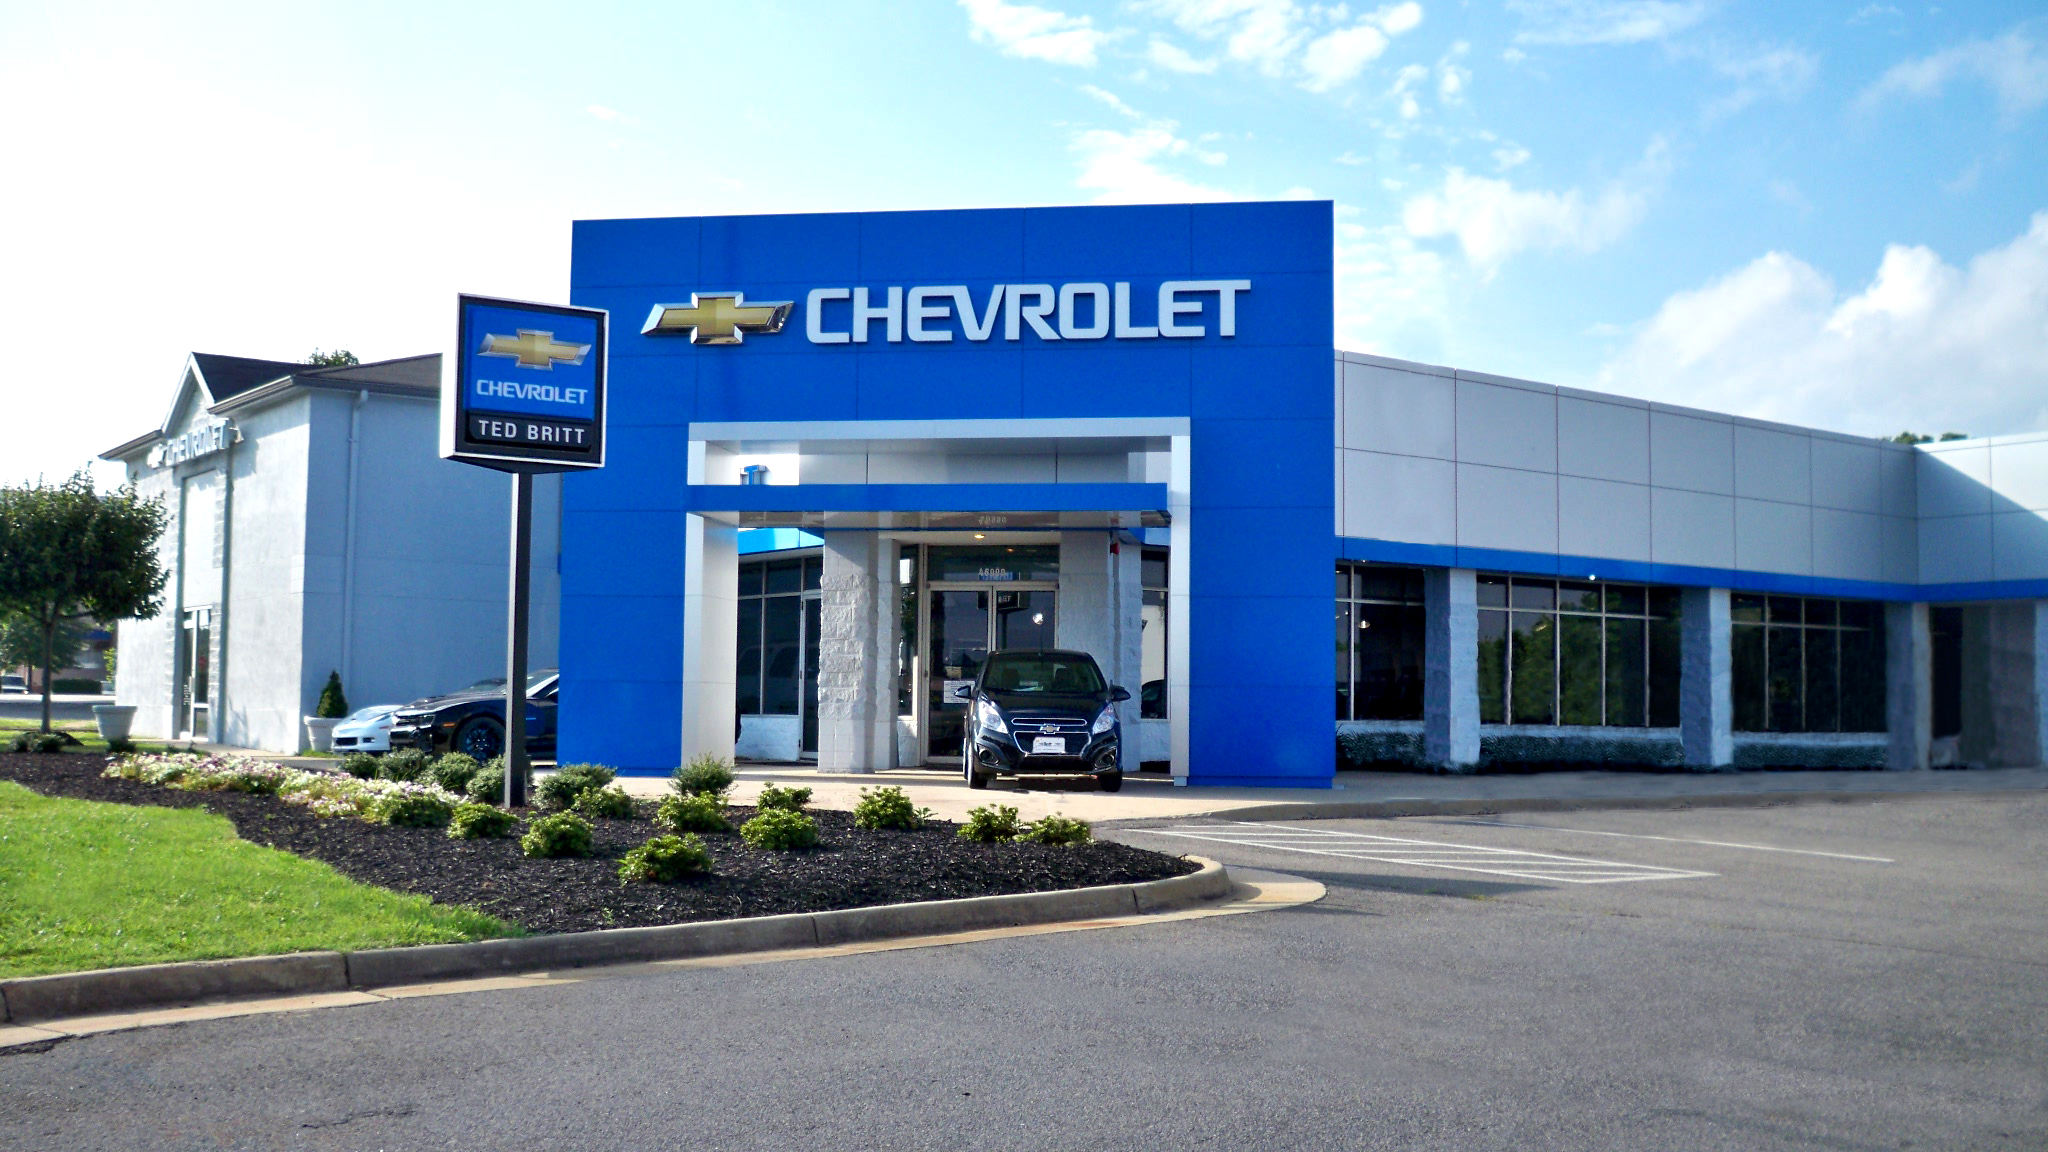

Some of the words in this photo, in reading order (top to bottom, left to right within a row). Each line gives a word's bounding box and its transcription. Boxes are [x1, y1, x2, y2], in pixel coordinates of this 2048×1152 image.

[806, 279, 1251, 344] CHEVROLET
[476, 379, 588, 404] CHEVROLET
[165, 417, 230, 467] CHEVROLET
[478, 420, 517, 439] TED
[527, 424, 585, 444] BRITT
